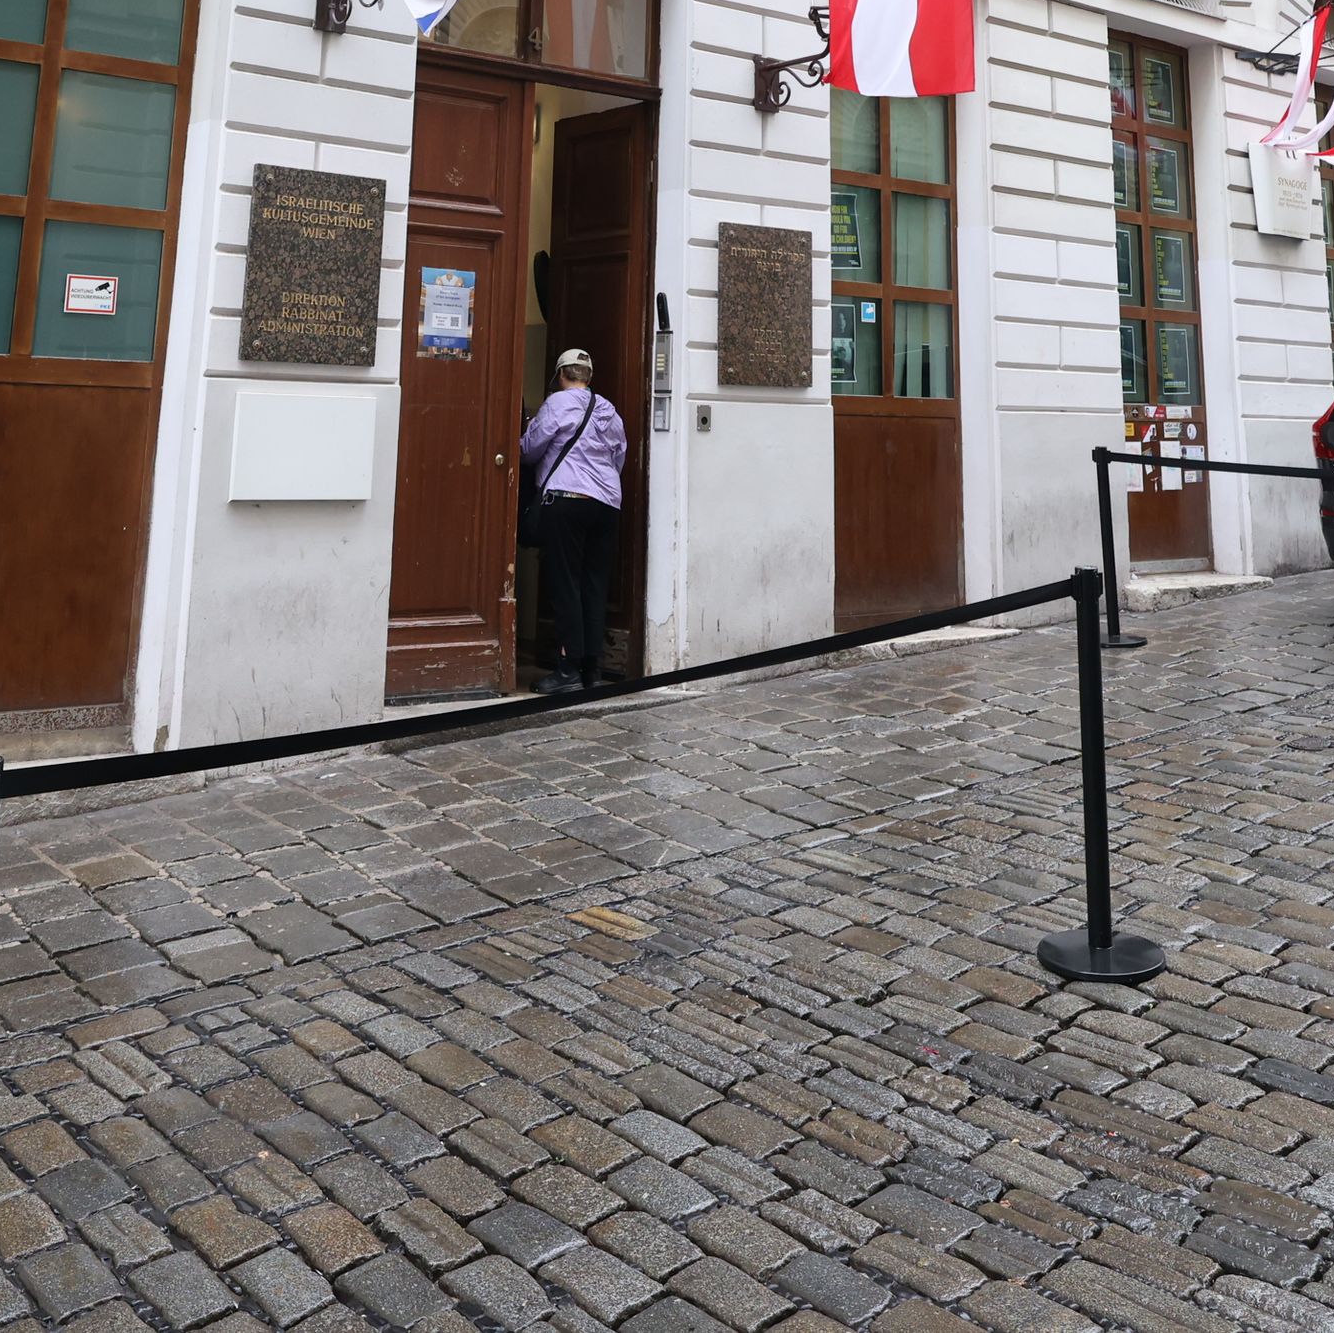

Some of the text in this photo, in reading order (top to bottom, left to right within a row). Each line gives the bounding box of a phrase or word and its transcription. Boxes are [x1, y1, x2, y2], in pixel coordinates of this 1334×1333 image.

[528, 26, 543, 51] 4
[1278, 177, 1307, 191] SYNAGOGE
[276, 195, 364, 215] ISRAELITISCHE
[262, 208, 376, 230] KULTUSGEMEINDE
[302, 226, 337, 240] WIEN
[281, 292, 346, 307] DIREKTION
[281, 307, 344, 322] RABBINAT
[257, 320, 364, 338] ADMINISTRATION
